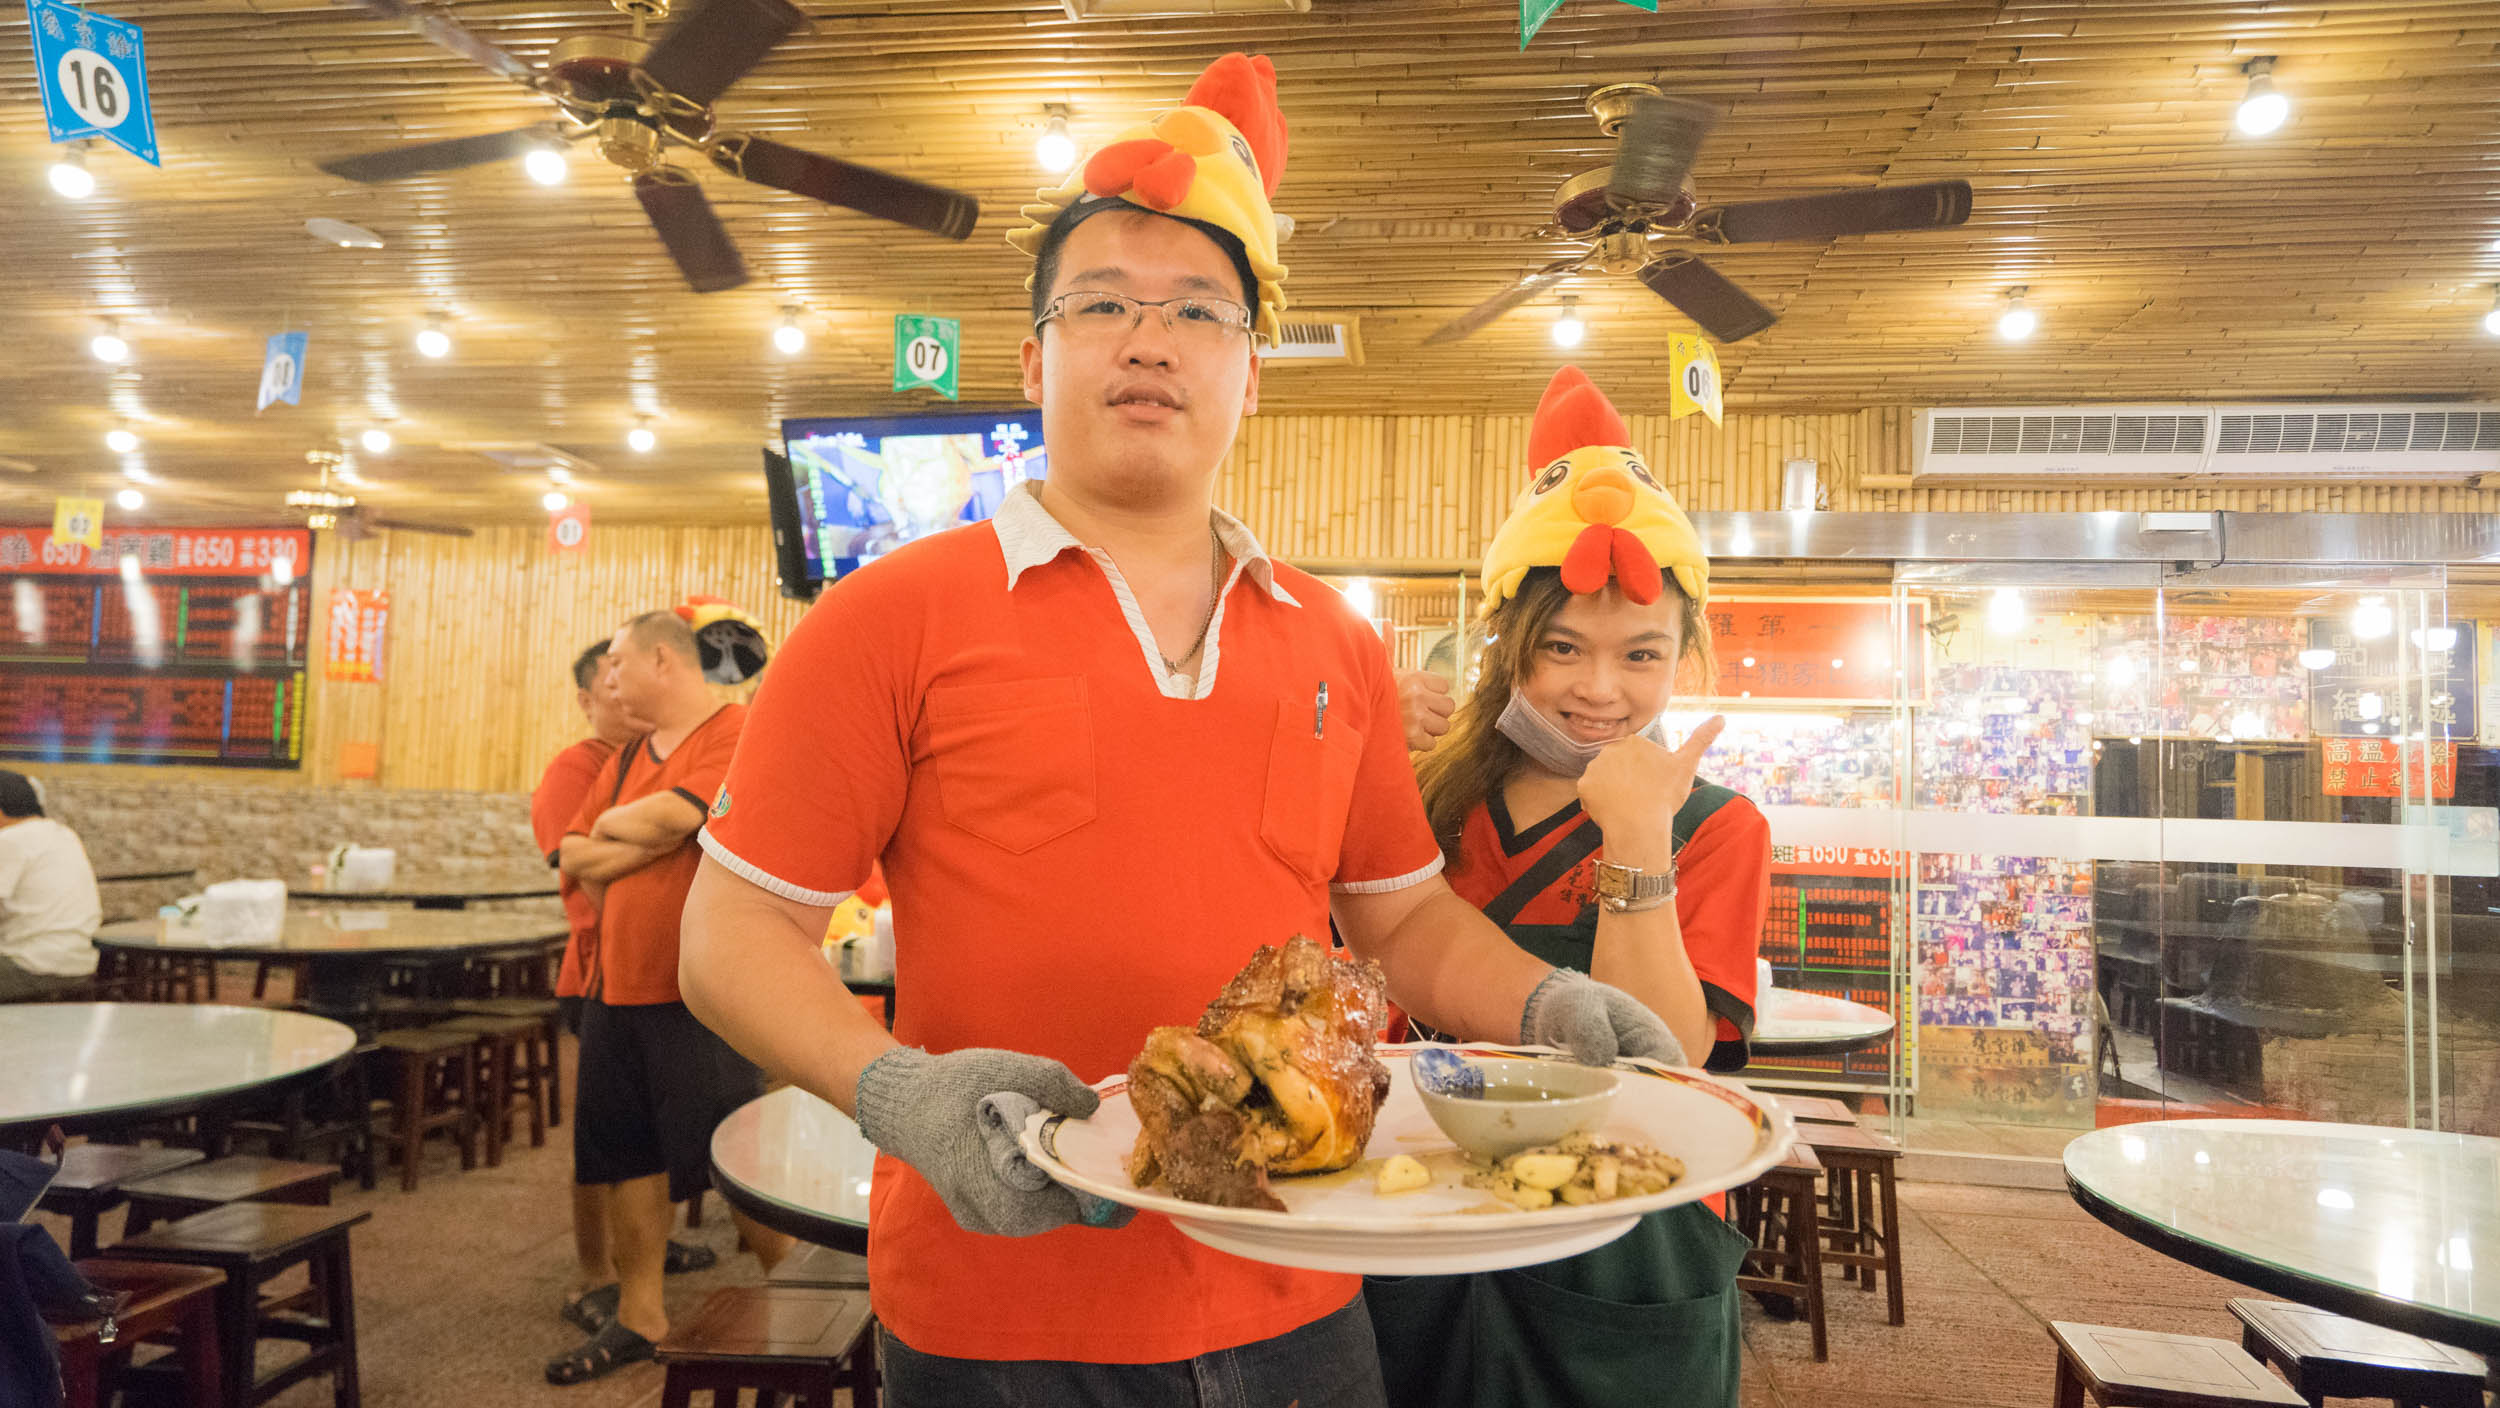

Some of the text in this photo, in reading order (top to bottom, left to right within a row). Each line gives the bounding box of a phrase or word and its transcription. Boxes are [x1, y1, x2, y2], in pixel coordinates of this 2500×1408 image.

[70, 60, 118, 118] 16
[914, 341, 941, 371] 07
[193, 536, 235, 566] 650
